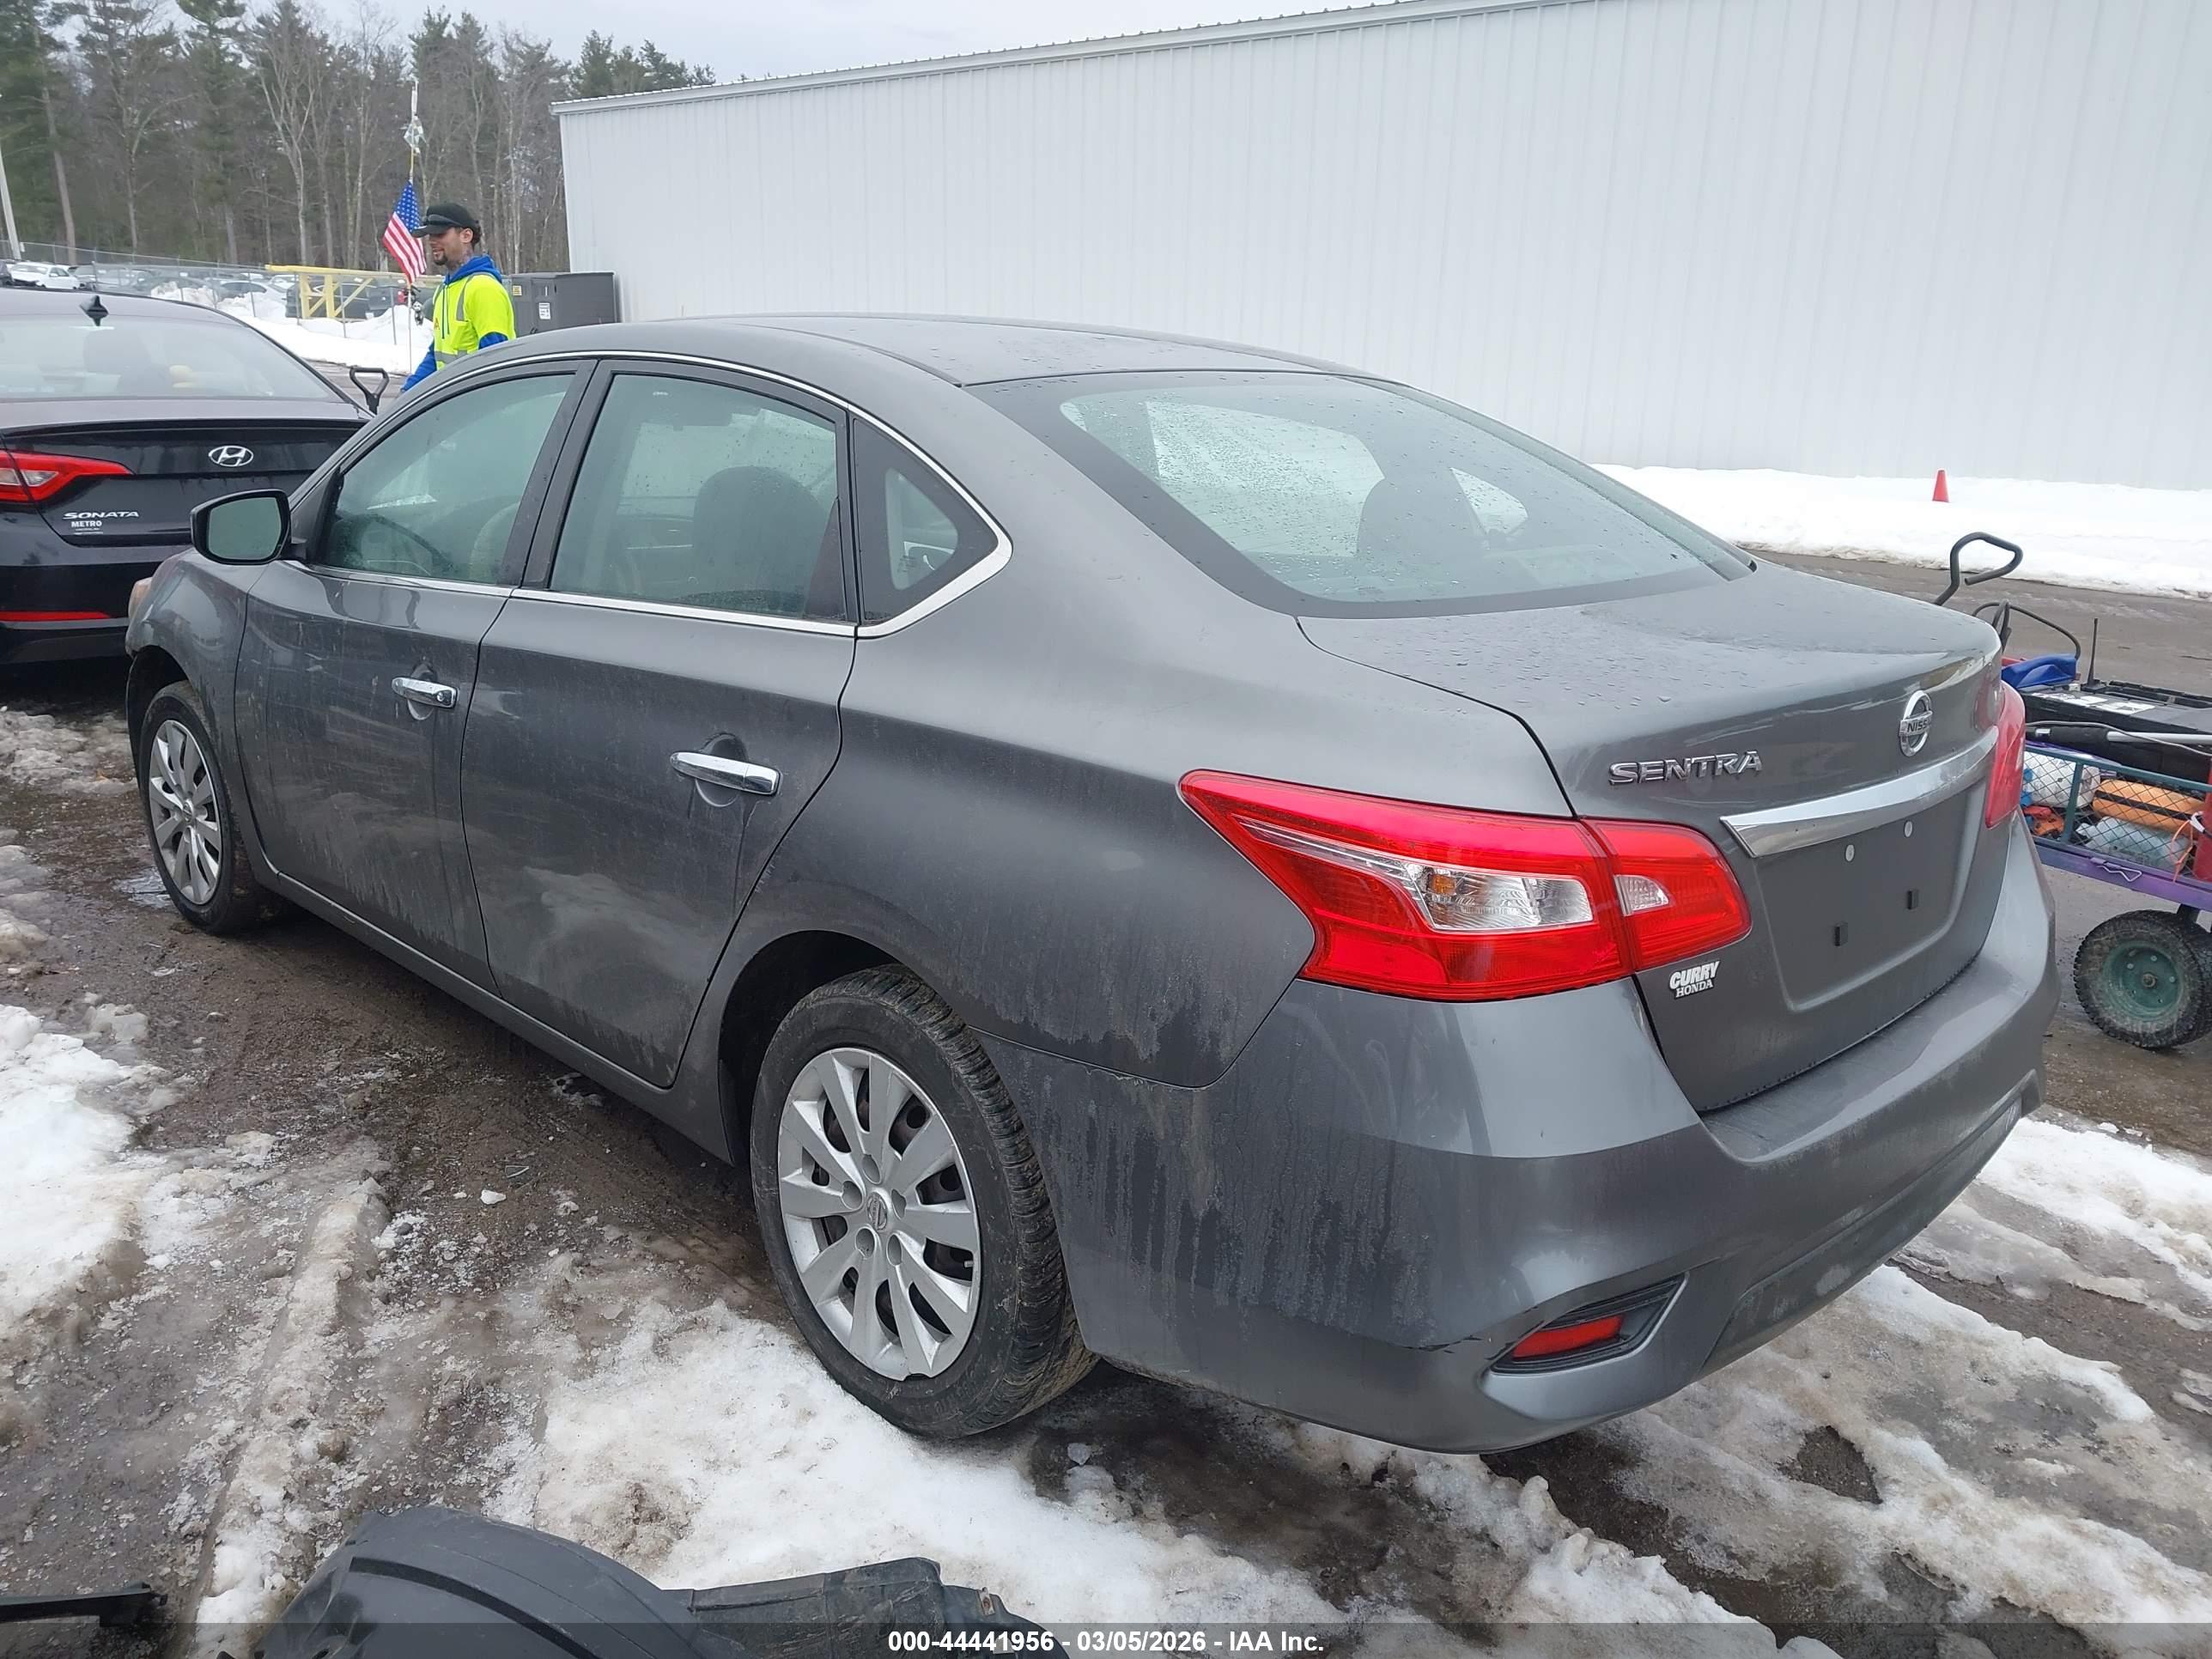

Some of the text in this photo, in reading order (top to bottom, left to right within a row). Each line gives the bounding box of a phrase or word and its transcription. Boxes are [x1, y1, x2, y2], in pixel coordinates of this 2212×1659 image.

[63, 511, 139, 520] SONATA
[70, 520, 102, 528] METRO
[1906, 719, 1930, 733] NISS
[1608, 750, 1762, 785] SENTRA
[1669, 960, 1720, 990] CURRY
[1675, 979, 1714, 998] HONDA
